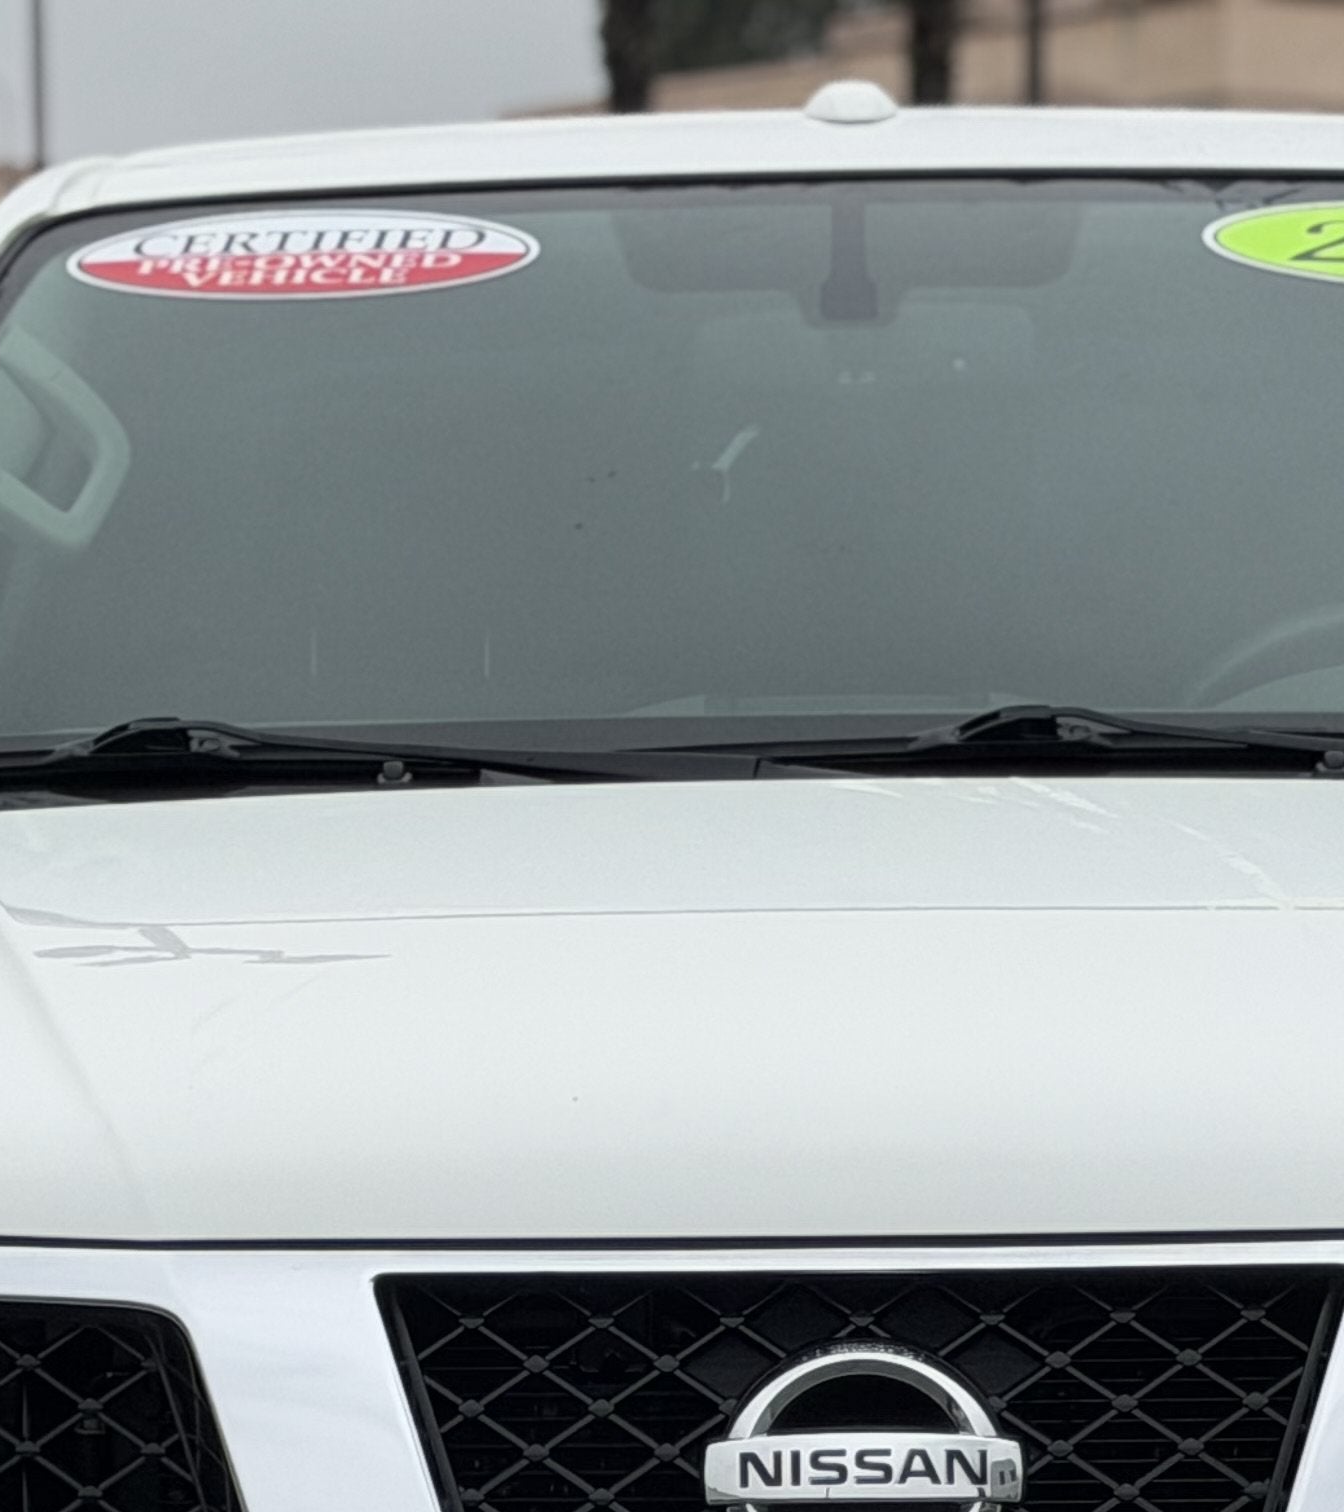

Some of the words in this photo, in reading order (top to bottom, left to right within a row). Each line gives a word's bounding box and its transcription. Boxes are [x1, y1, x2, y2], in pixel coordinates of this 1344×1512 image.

[133, 228, 487, 257] CERTIFIED
[137, 253, 463, 276] PRE-OWNED
[182, 267, 411, 287] VEHICLE
[738, 1448, 989, 1488] NISSAN
